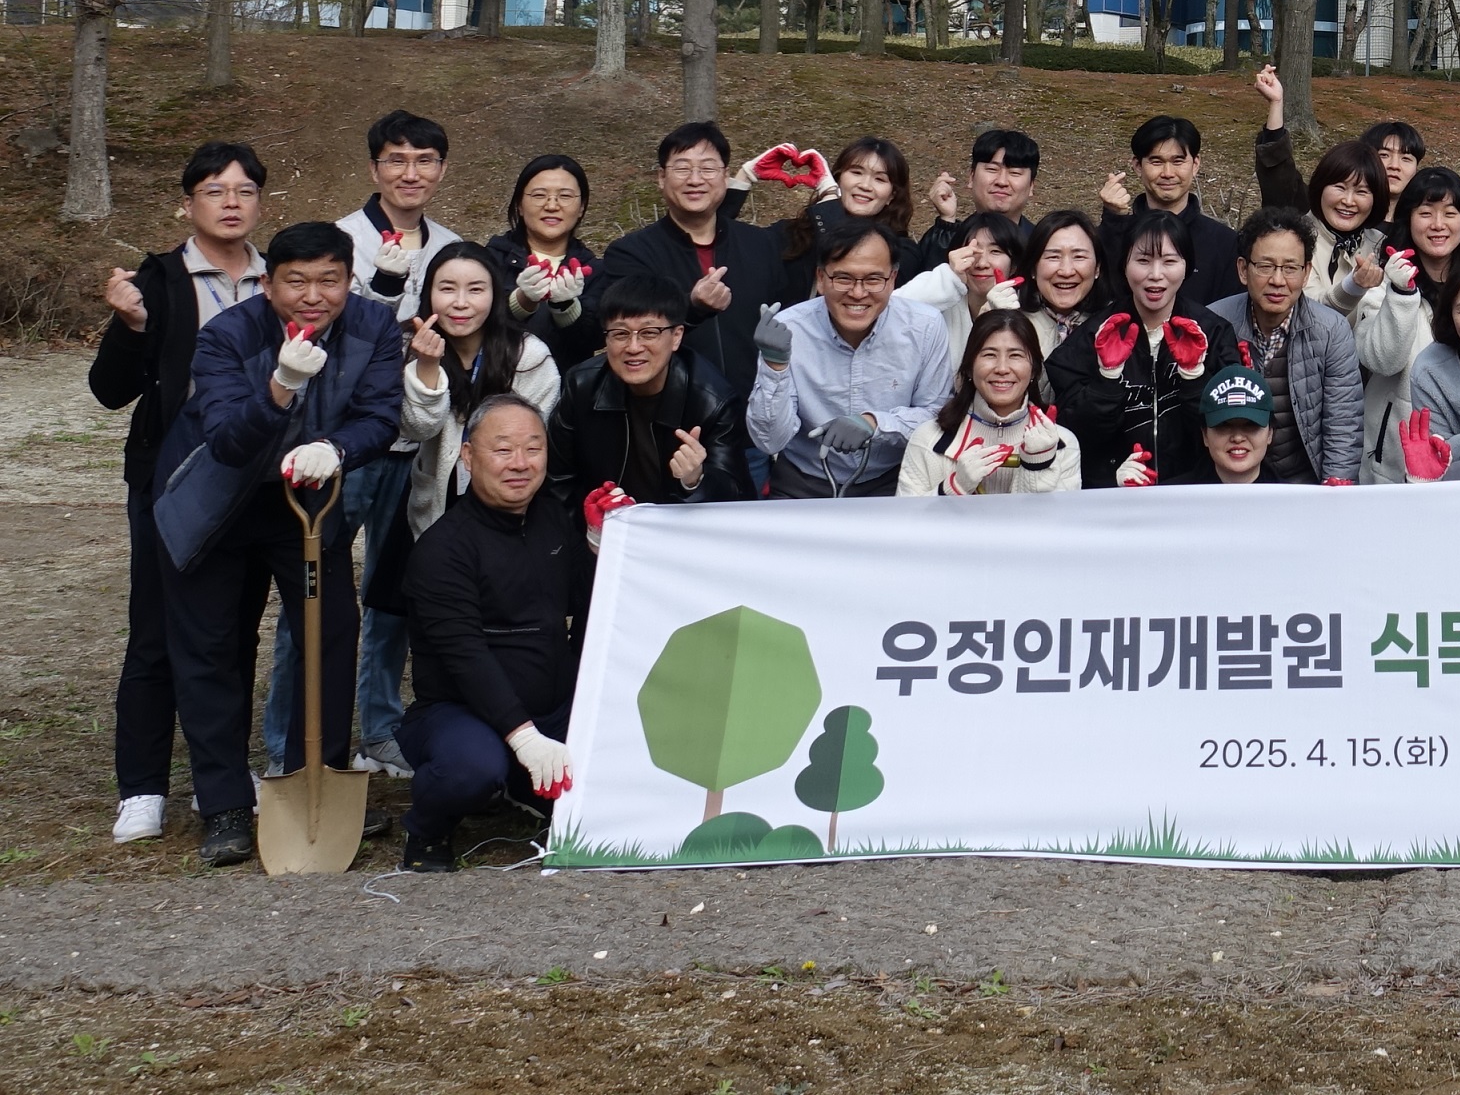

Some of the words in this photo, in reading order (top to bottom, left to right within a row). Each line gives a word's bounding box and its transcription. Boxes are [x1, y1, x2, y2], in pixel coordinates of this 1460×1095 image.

[1209, 376, 1265, 401] POLHAM
[876, 612, 1343, 696] 우정인재개발원
[1199, 738, 1296, 768] 2025.
[1306, 738, 1336, 767] 4.
[1347, 735, 1449, 768] 15.(화)
